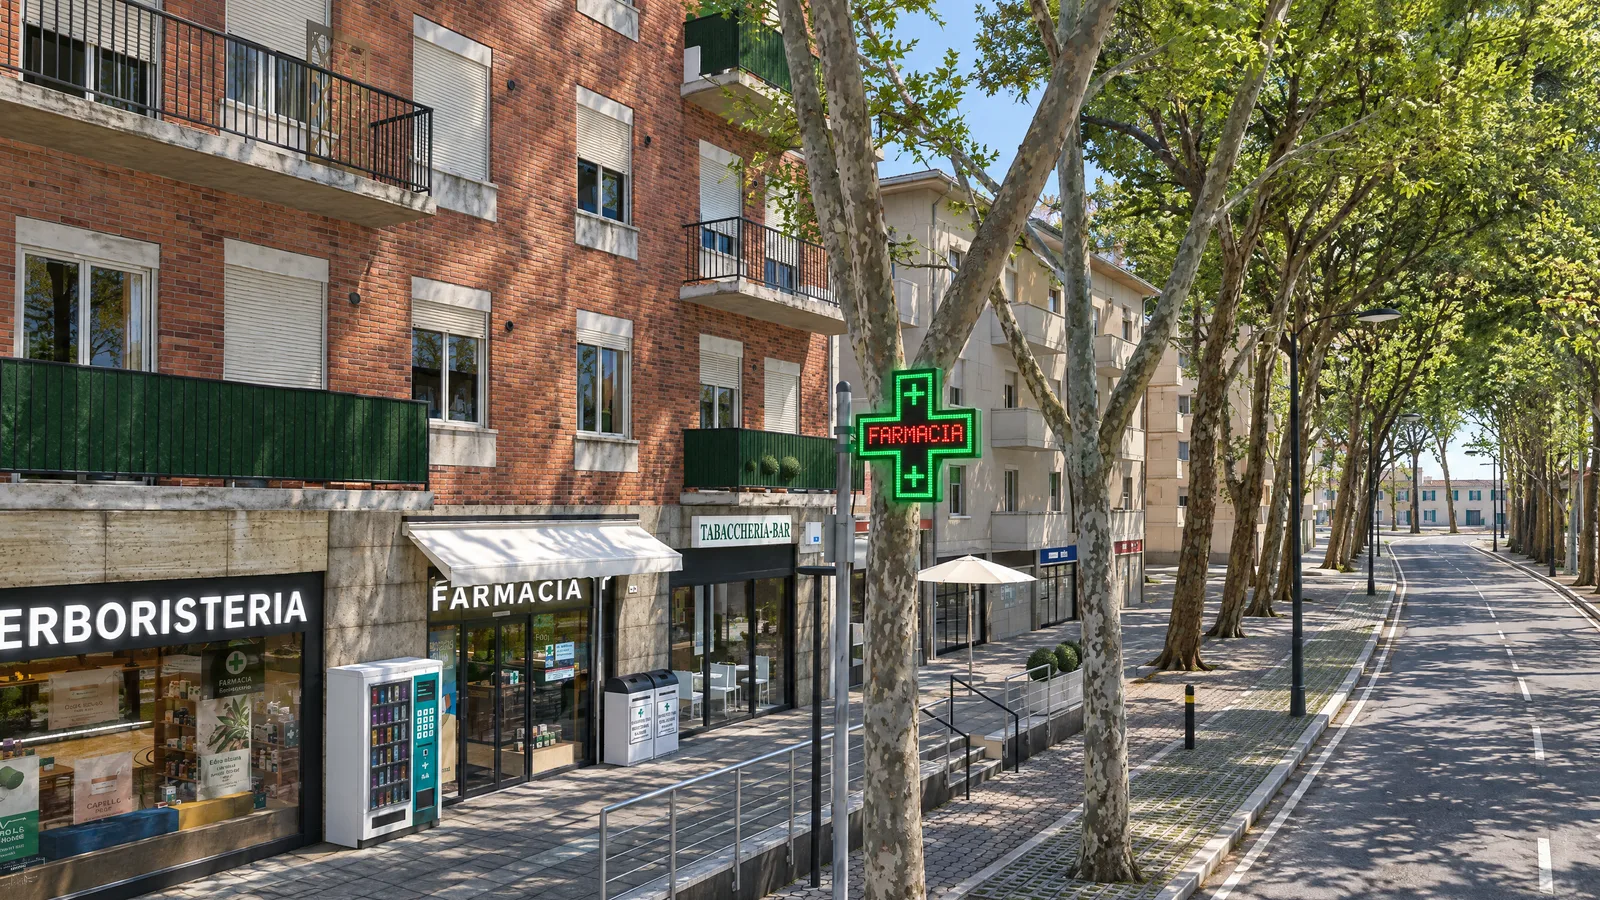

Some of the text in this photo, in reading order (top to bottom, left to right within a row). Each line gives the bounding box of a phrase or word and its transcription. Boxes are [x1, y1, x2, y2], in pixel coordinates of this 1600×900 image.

[868, 424, 963, 444] FARMACIA
[700, 522, 791, 541] TABACCHERIA-BAR
[432, 579, 582, 611] FARMACIA
[0, 591, 307, 650] ERBORISTERIA
[219, 676, 252, 686] FARMACIA
